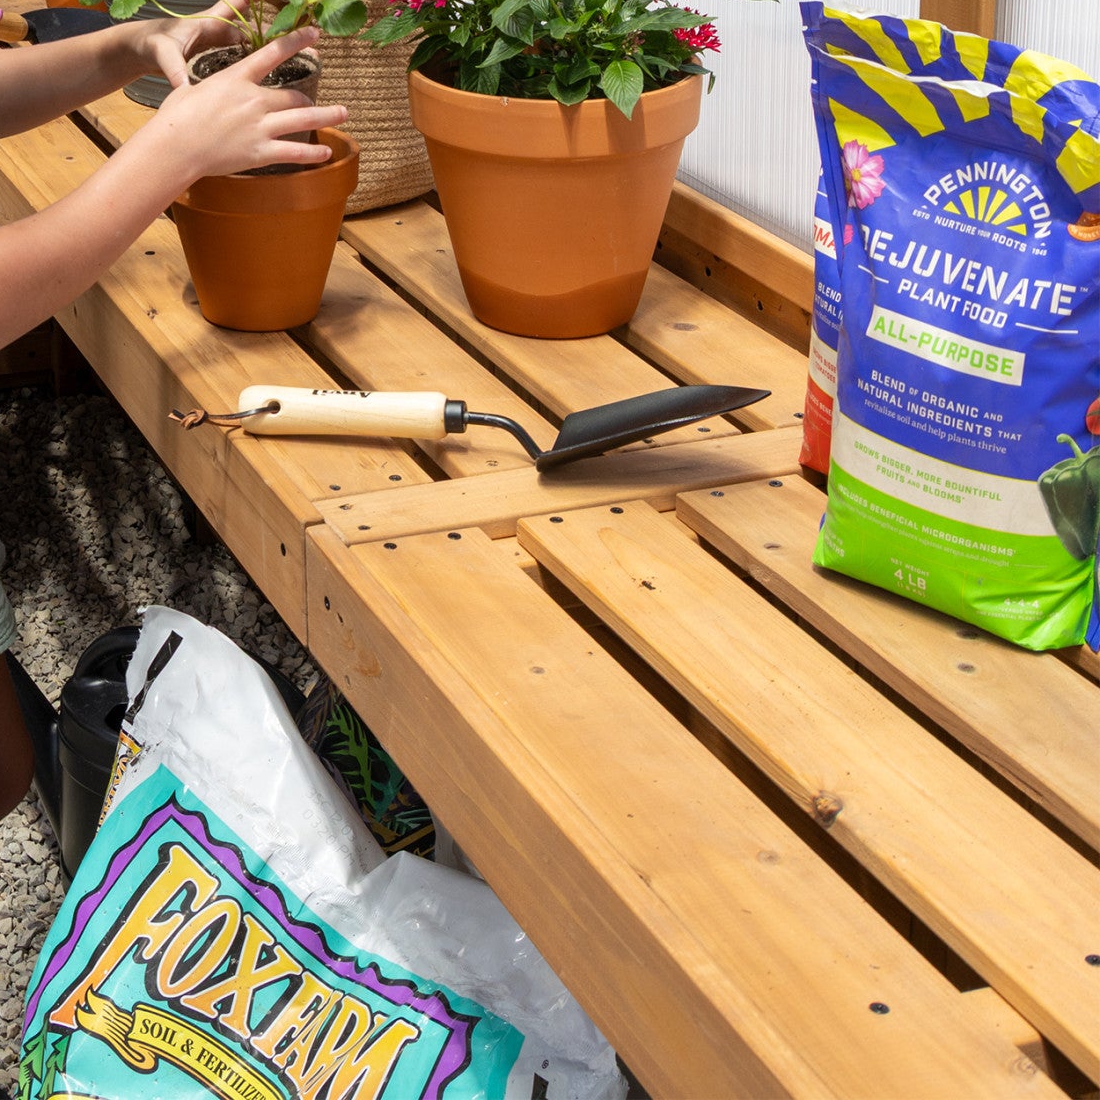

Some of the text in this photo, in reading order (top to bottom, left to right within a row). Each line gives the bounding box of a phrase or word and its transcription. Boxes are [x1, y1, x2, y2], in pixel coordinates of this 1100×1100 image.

[923, 161, 1052, 239] PENNINGTON
[934, 215, 977, 236] NURTURE
[977, 228, 991, 239] YOUR
[992, 233, 1028, 253] ROOTS
[817, 282, 842, 303] BLEND
[897, 279, 1009, 329] PLANT FOOD
[873, 315, 1015, 377] ALL-PURPOSE
[857, 378, 1022, 441] NATURAL INGREDIENTS THAT
[871, 369, 1004, 423] BLEND OF ORGANIC AND
[864, 398, 1007, 454] revitalize soil and help plants thrive
[853, 441, 880, 460] GROWS
[916, 470, 943, 485] MORE
[945, 480, 1002, 501] BOUNTIFUL
[876, 464, 905, 484] FRUITS
[907, 480, 921, 489] AND
[869, 503, 919, 530] BENEFICIAL
[894, 569, 926, 590] 4 LB
[139, 1018, 177, 1048] SOIL
[180, 1038, 195, 1056] &
